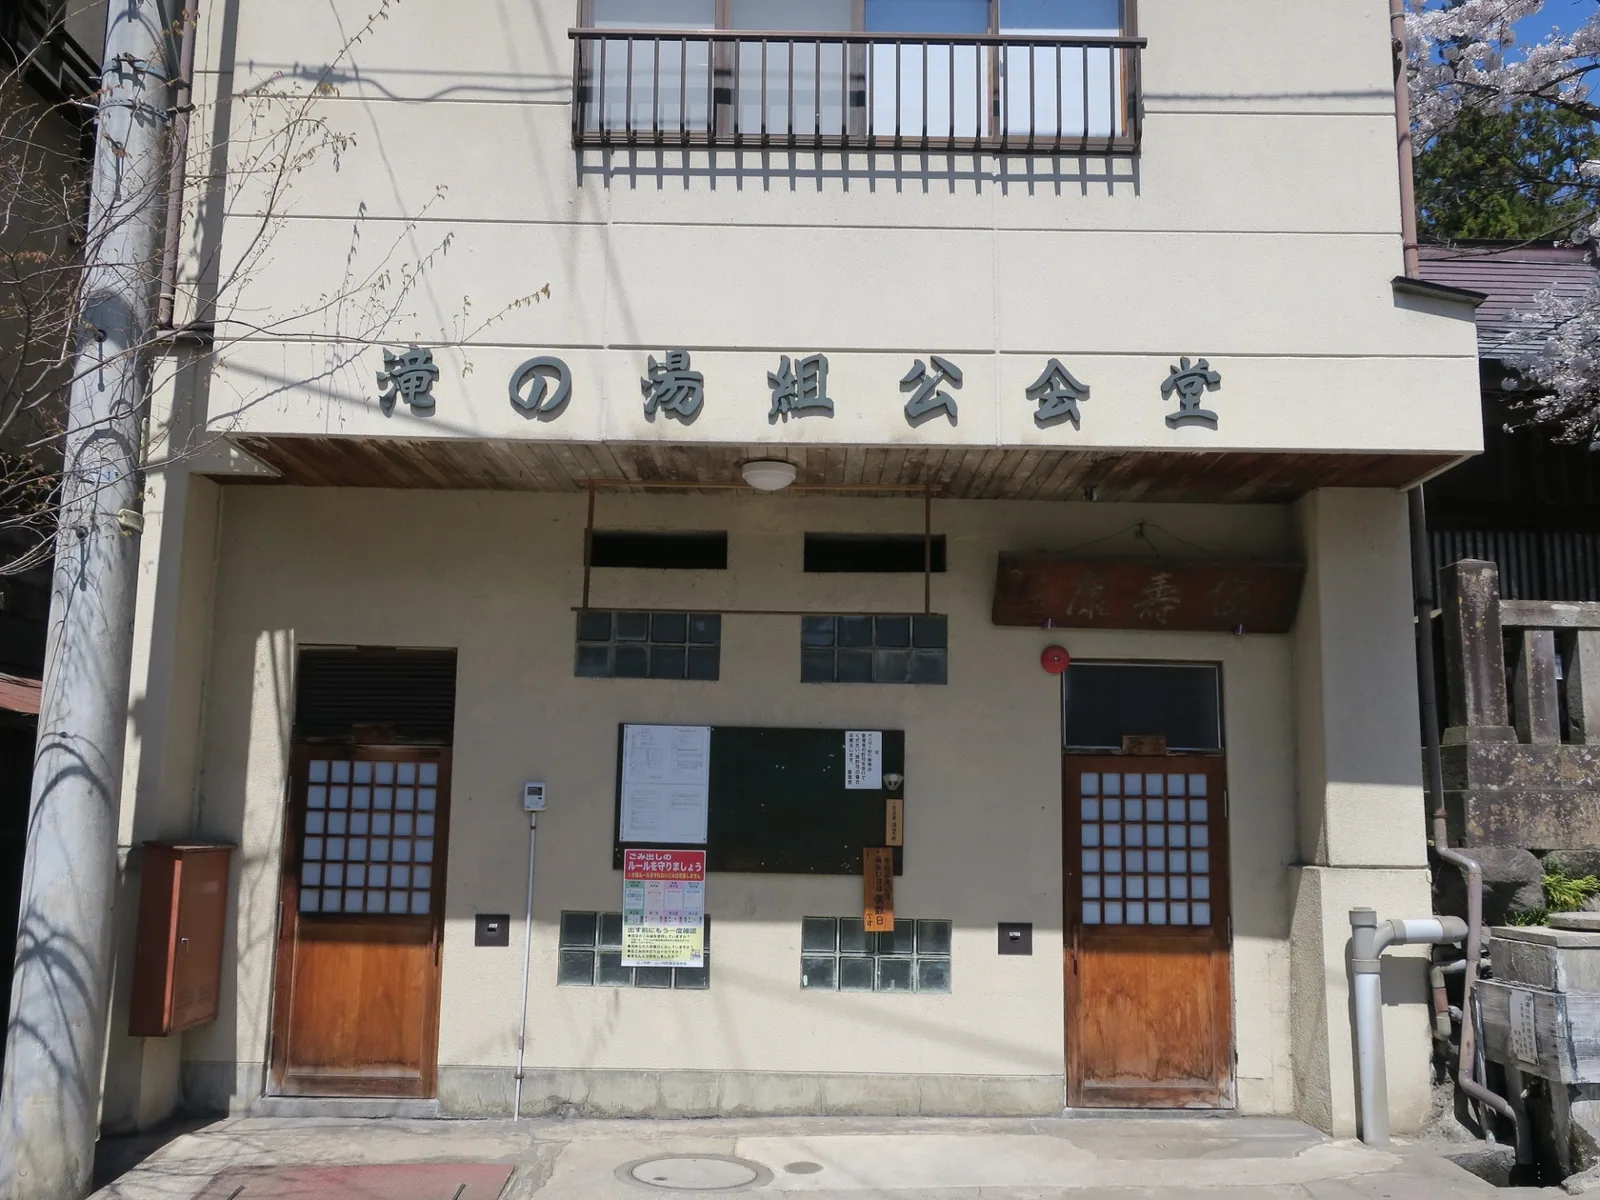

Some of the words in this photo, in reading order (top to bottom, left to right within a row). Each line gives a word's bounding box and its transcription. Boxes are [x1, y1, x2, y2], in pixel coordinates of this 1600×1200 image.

[377, 349, 1222, 427] 滝の湯組公会堂
[629, 853, 671, 861] ごみ出しの
[628, 861, 702, 872] ルールを守りましょう
